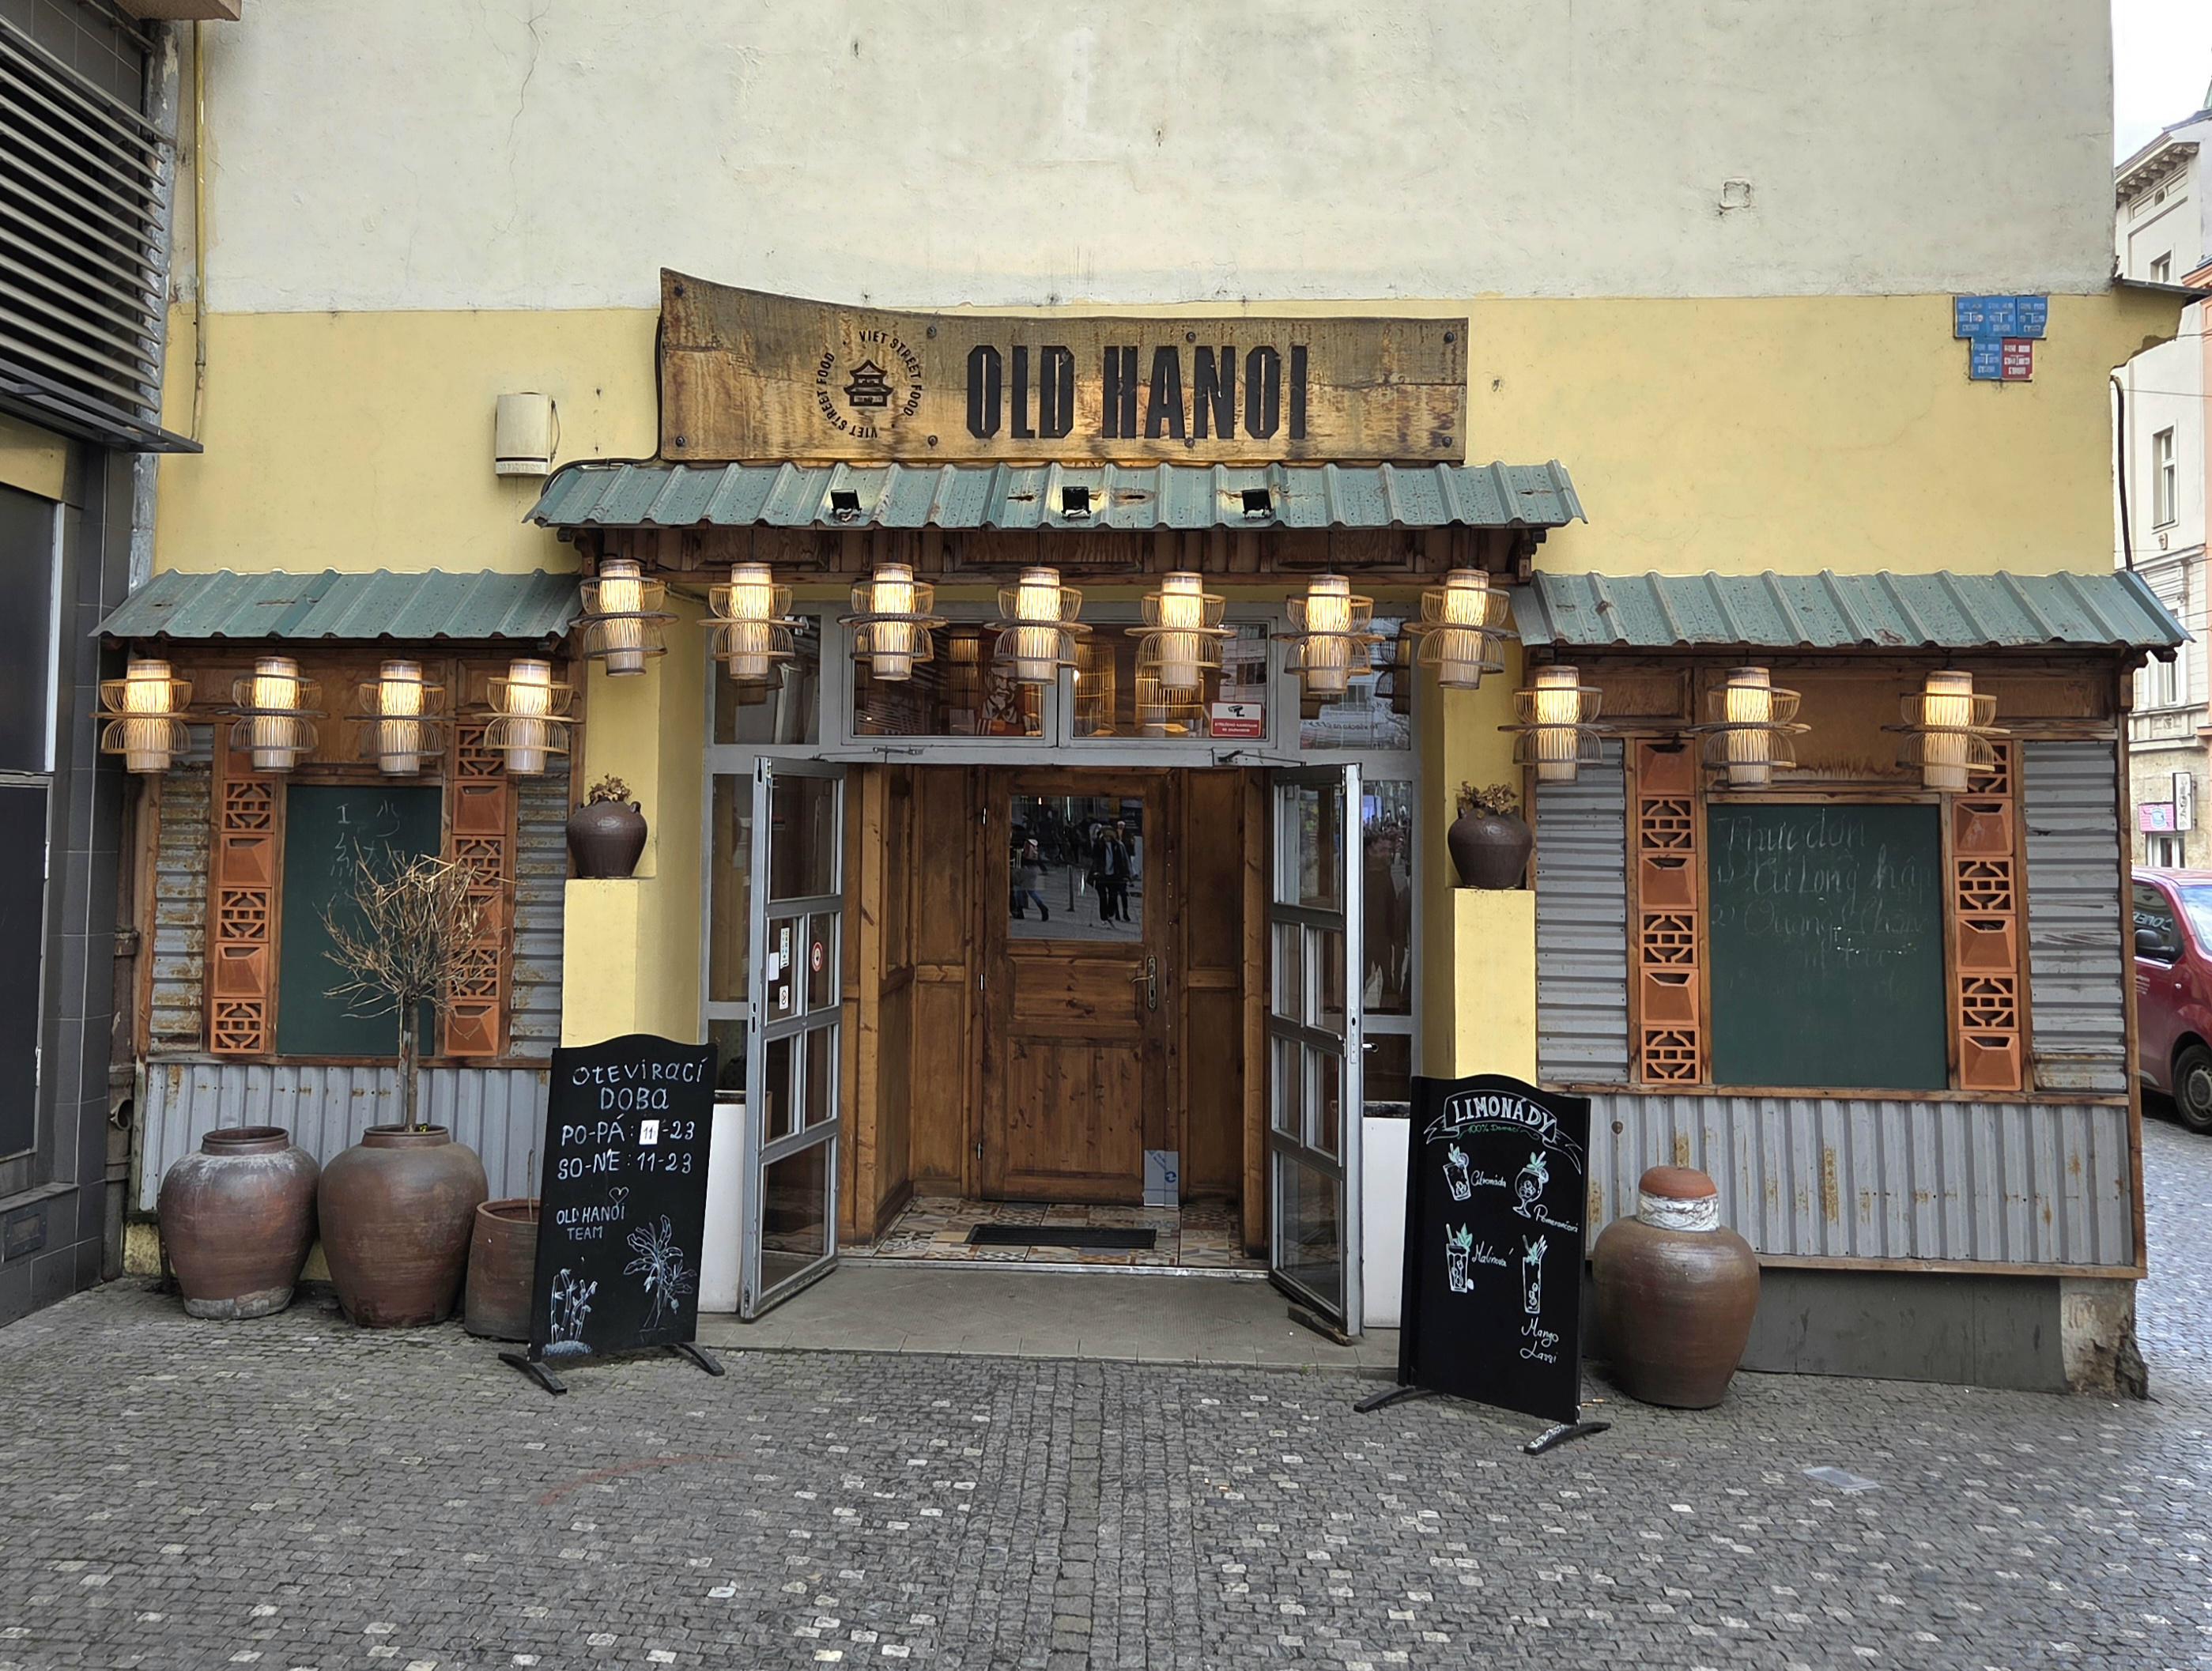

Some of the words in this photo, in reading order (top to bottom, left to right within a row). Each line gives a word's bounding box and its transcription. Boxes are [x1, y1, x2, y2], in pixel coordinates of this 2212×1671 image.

[859, 330, 889, 344] VIET
[816, 351, 836, 385] FOOD
[889, 338, 923, 379] STREET
[903, 384, 923, 417] FOOD
[965, 344, 1075, 440] OLD
[1101, 344, 1308, 440] HANOI
[816, 390, 848, 431] STREET
[848, 424, 878, 439] VIET
[1451, 1096, 1557, 1133] LIMONÁDY
[1468, 1124, 1489, 1134] 100%
[556, 1208, 579, 1225] OLD
[567, 1225, 603, 1241] TEAM
[1521, 1317, 1560, 1348] Mango
